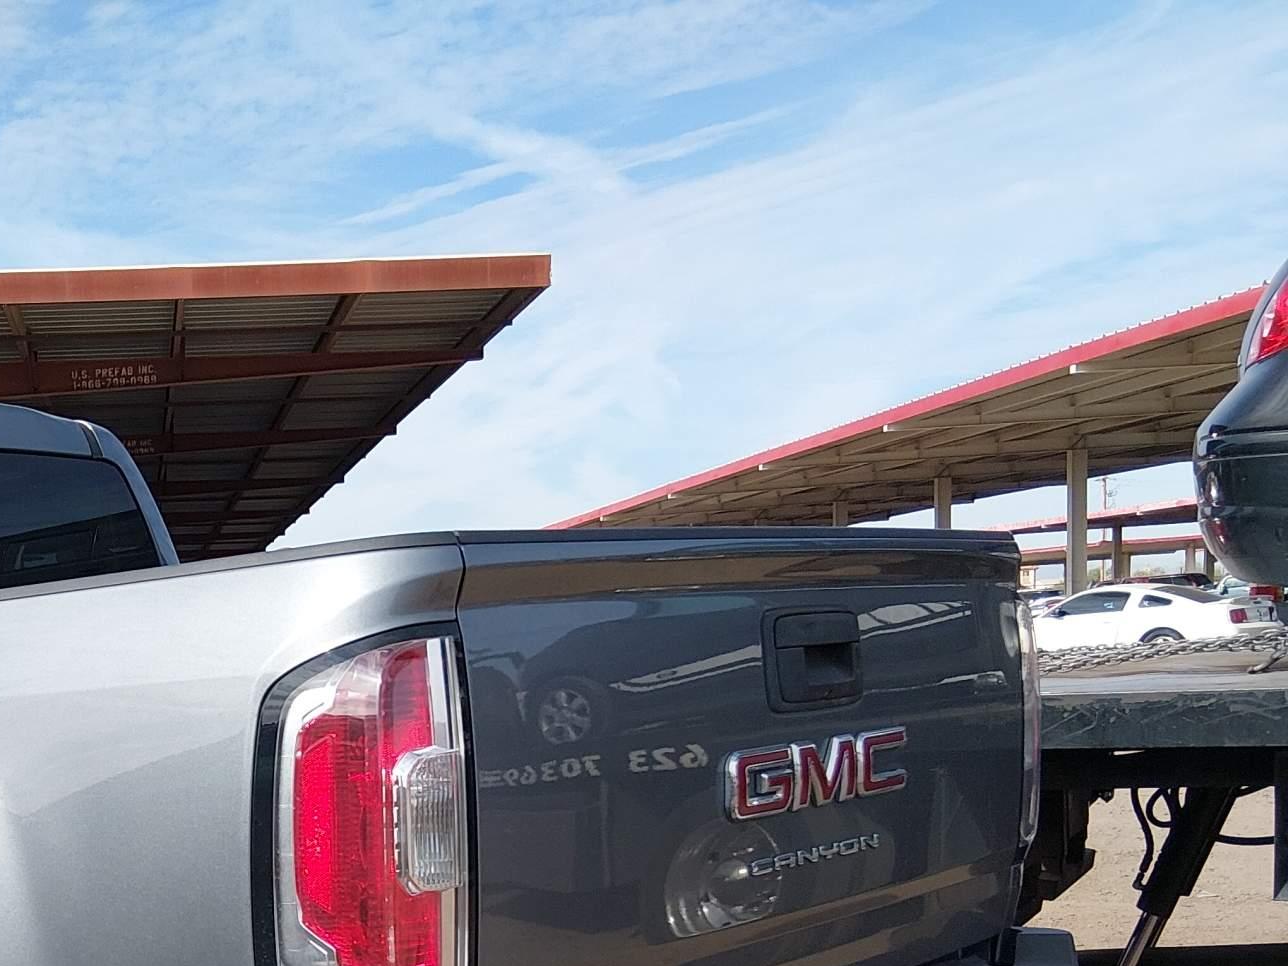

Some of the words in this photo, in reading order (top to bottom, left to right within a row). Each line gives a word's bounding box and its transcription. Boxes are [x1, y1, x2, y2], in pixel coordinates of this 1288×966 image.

[71, 369, 92, 380] U.S.
[95, 366, 134, 379] PREFAB
[725, 725, 908, 822] GMC
[750, 832, 881, 877] CANYON
